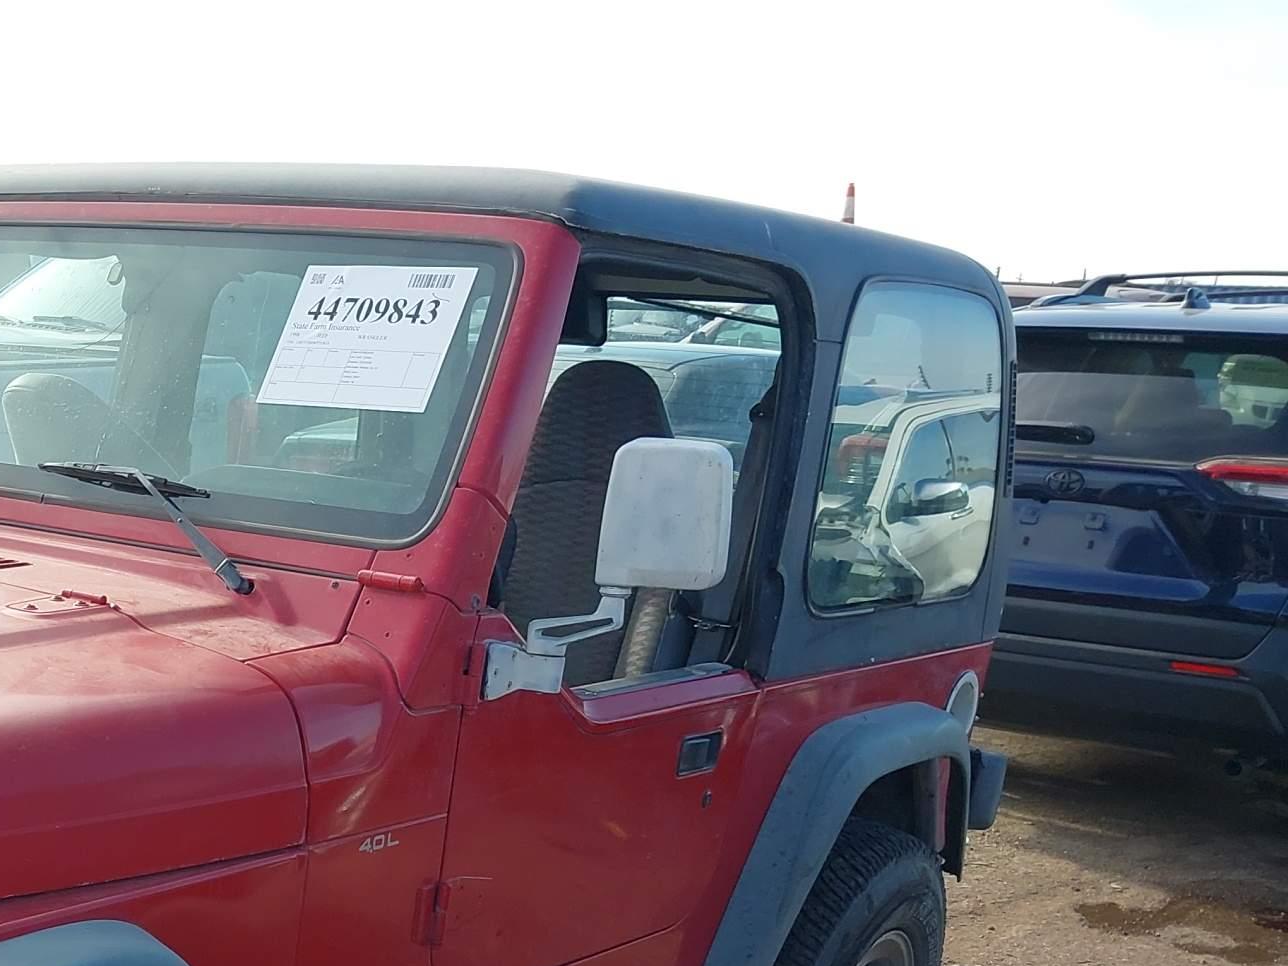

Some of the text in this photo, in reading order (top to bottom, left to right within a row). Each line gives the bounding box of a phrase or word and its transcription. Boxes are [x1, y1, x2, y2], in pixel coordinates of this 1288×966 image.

[307, 296, 441, 325] 44709843
[292, 321, 361, 332] State Farm Insurance
